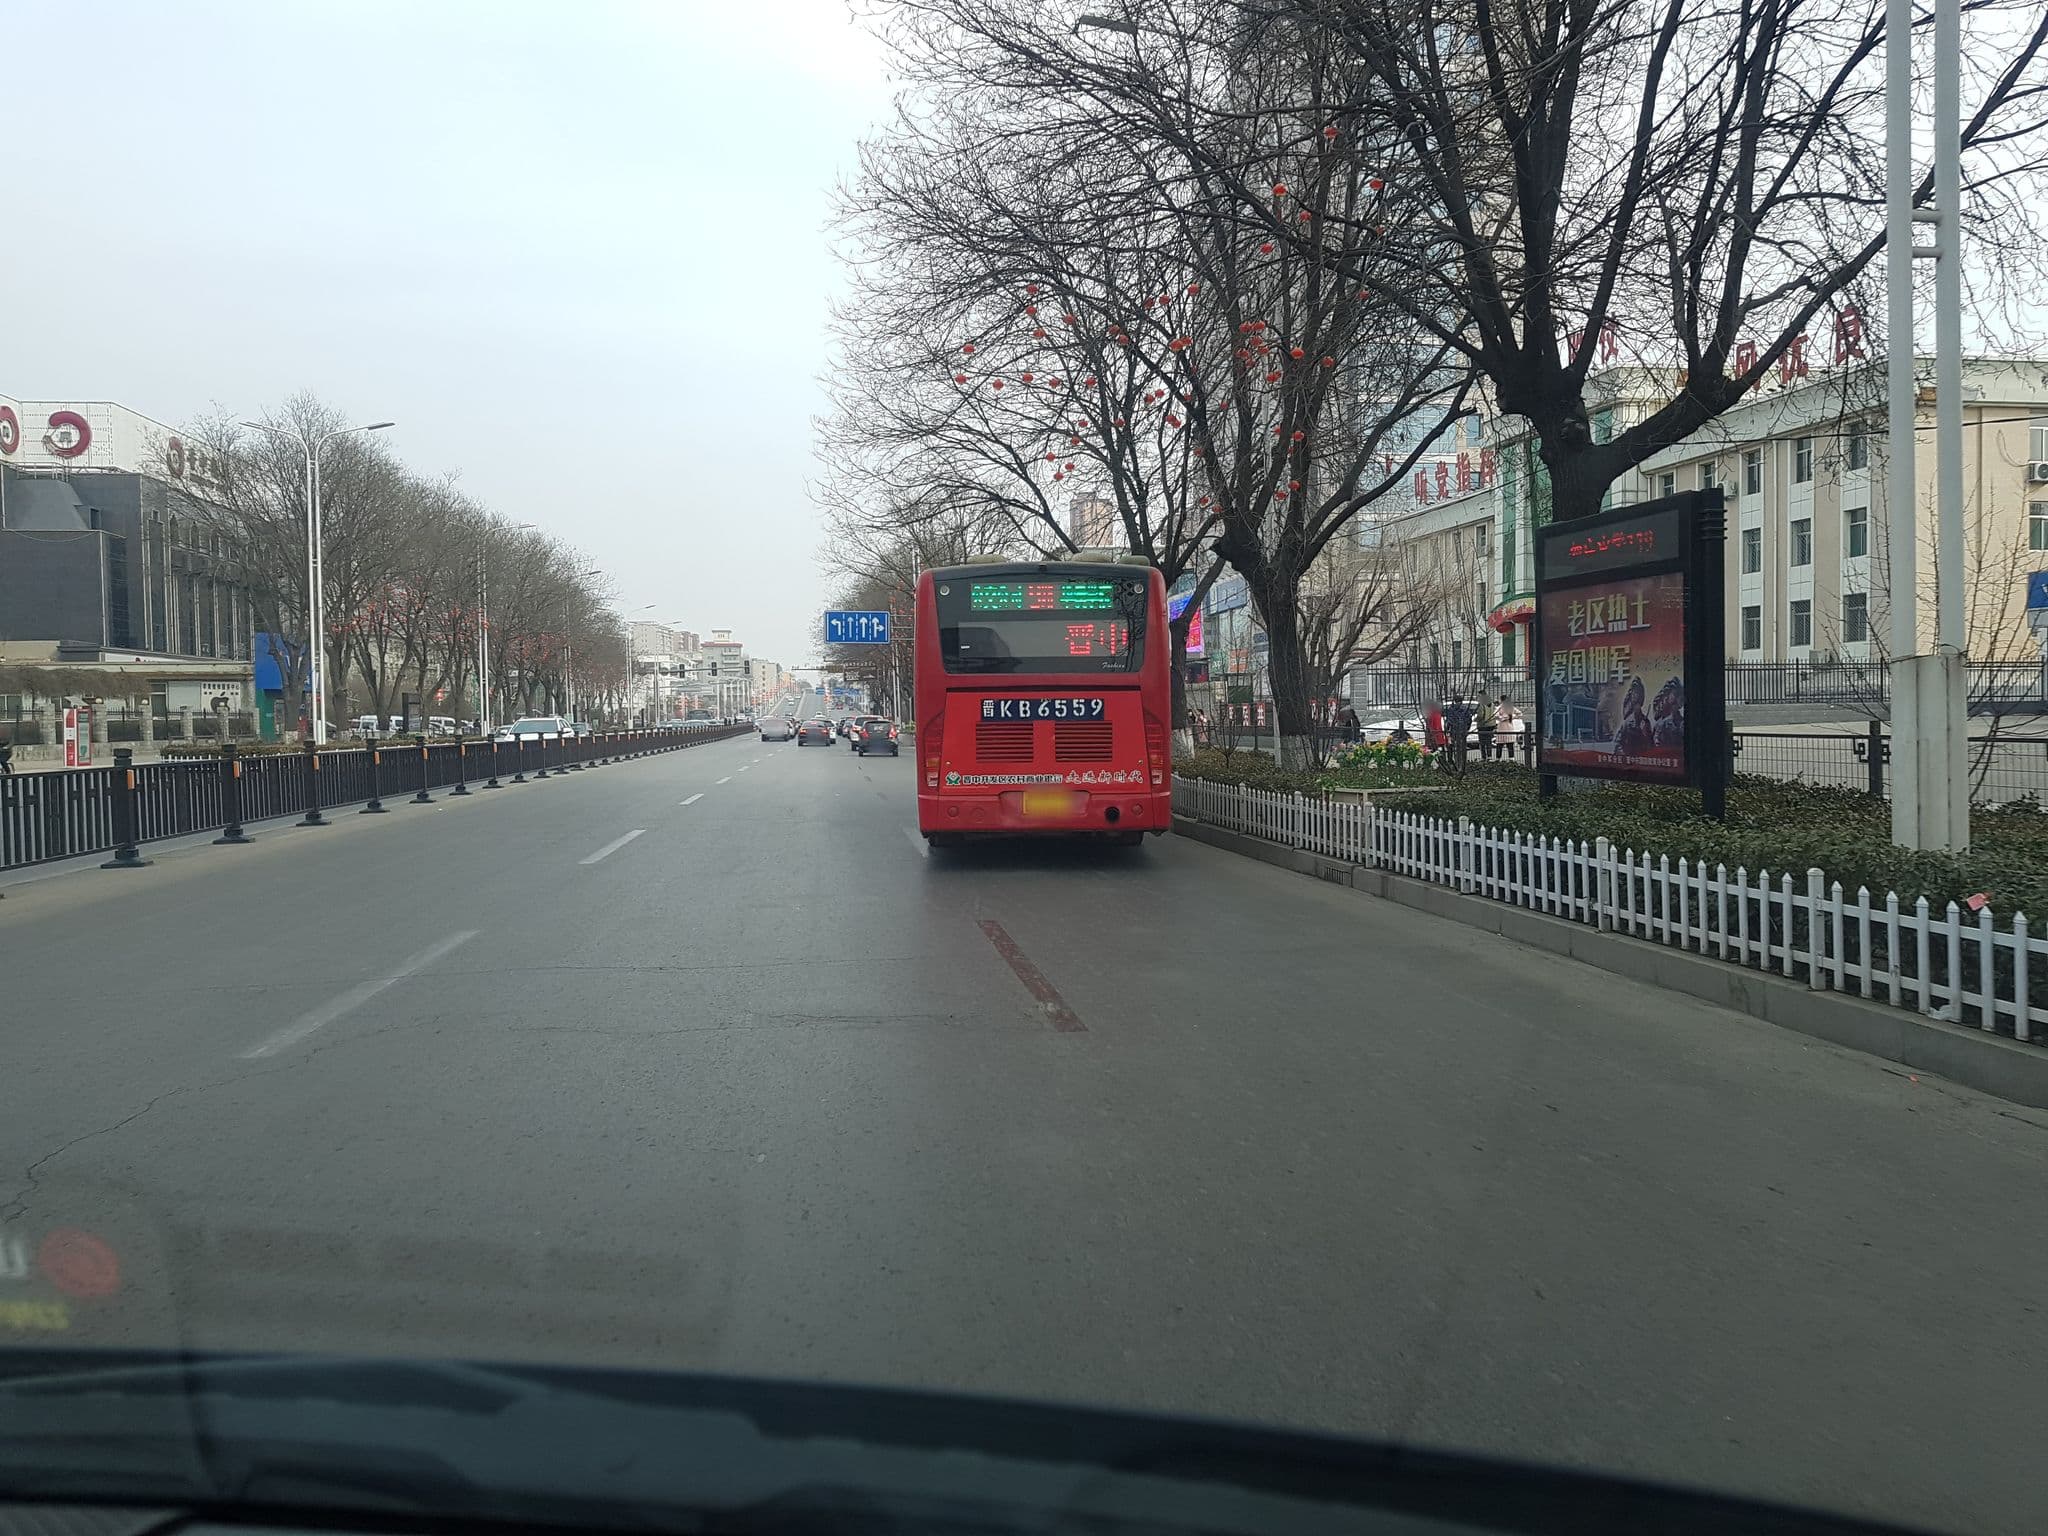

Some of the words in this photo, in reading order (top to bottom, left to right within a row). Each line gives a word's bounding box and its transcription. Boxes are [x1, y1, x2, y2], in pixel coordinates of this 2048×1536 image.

[1567, 591, 1651, 637] 老区热土
[1551, 645, 1632, 686] 爱国拥军
